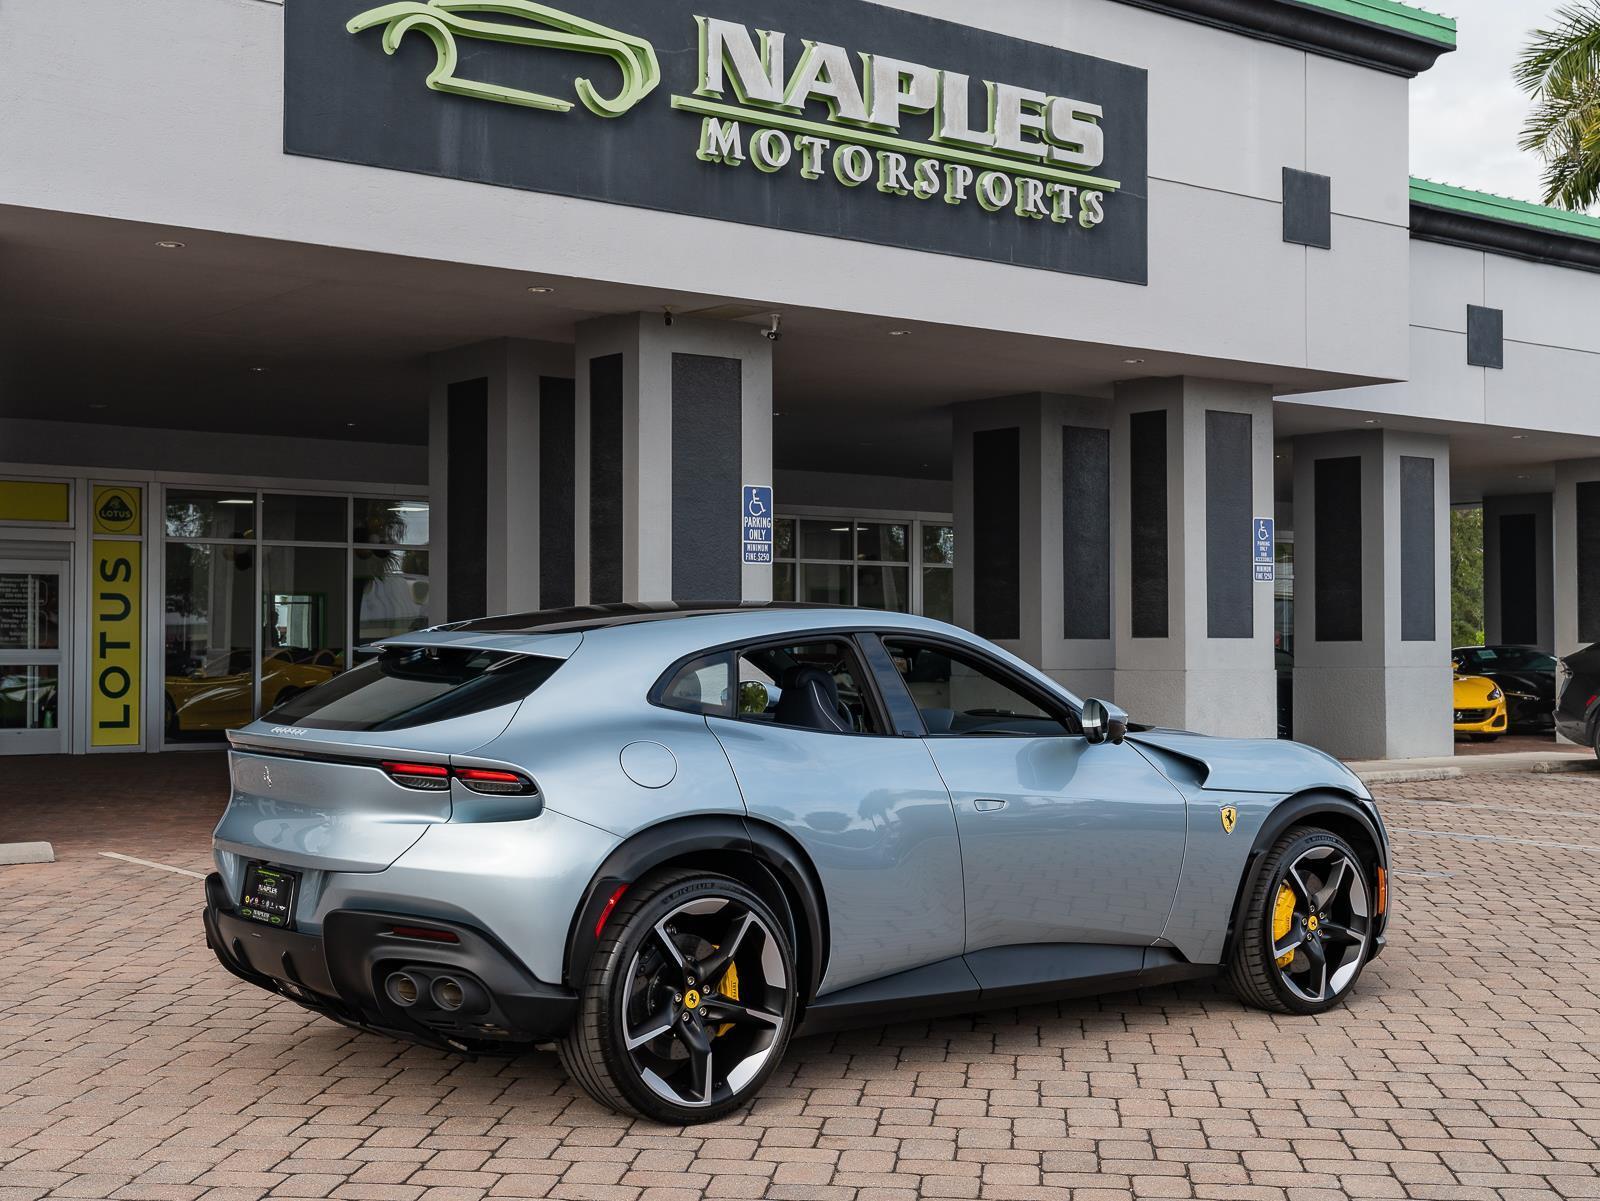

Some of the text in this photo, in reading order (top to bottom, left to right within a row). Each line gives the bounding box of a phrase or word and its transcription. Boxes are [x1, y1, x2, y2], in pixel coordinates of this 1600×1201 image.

[692, 15, 1104, 171] NAPLES
[696, 116, 1104, 229] MOTORSPORTS
[101, 510, 131, 518] LOTUS
[744, 516, 771, 529] PARKING
[749, 529, 766, 540] ONLY
[746, 543, 769, 552] MINIMUM
[745, 552, 770, 561] FINE $250
[99, 557, 131, 729] LOTUS
